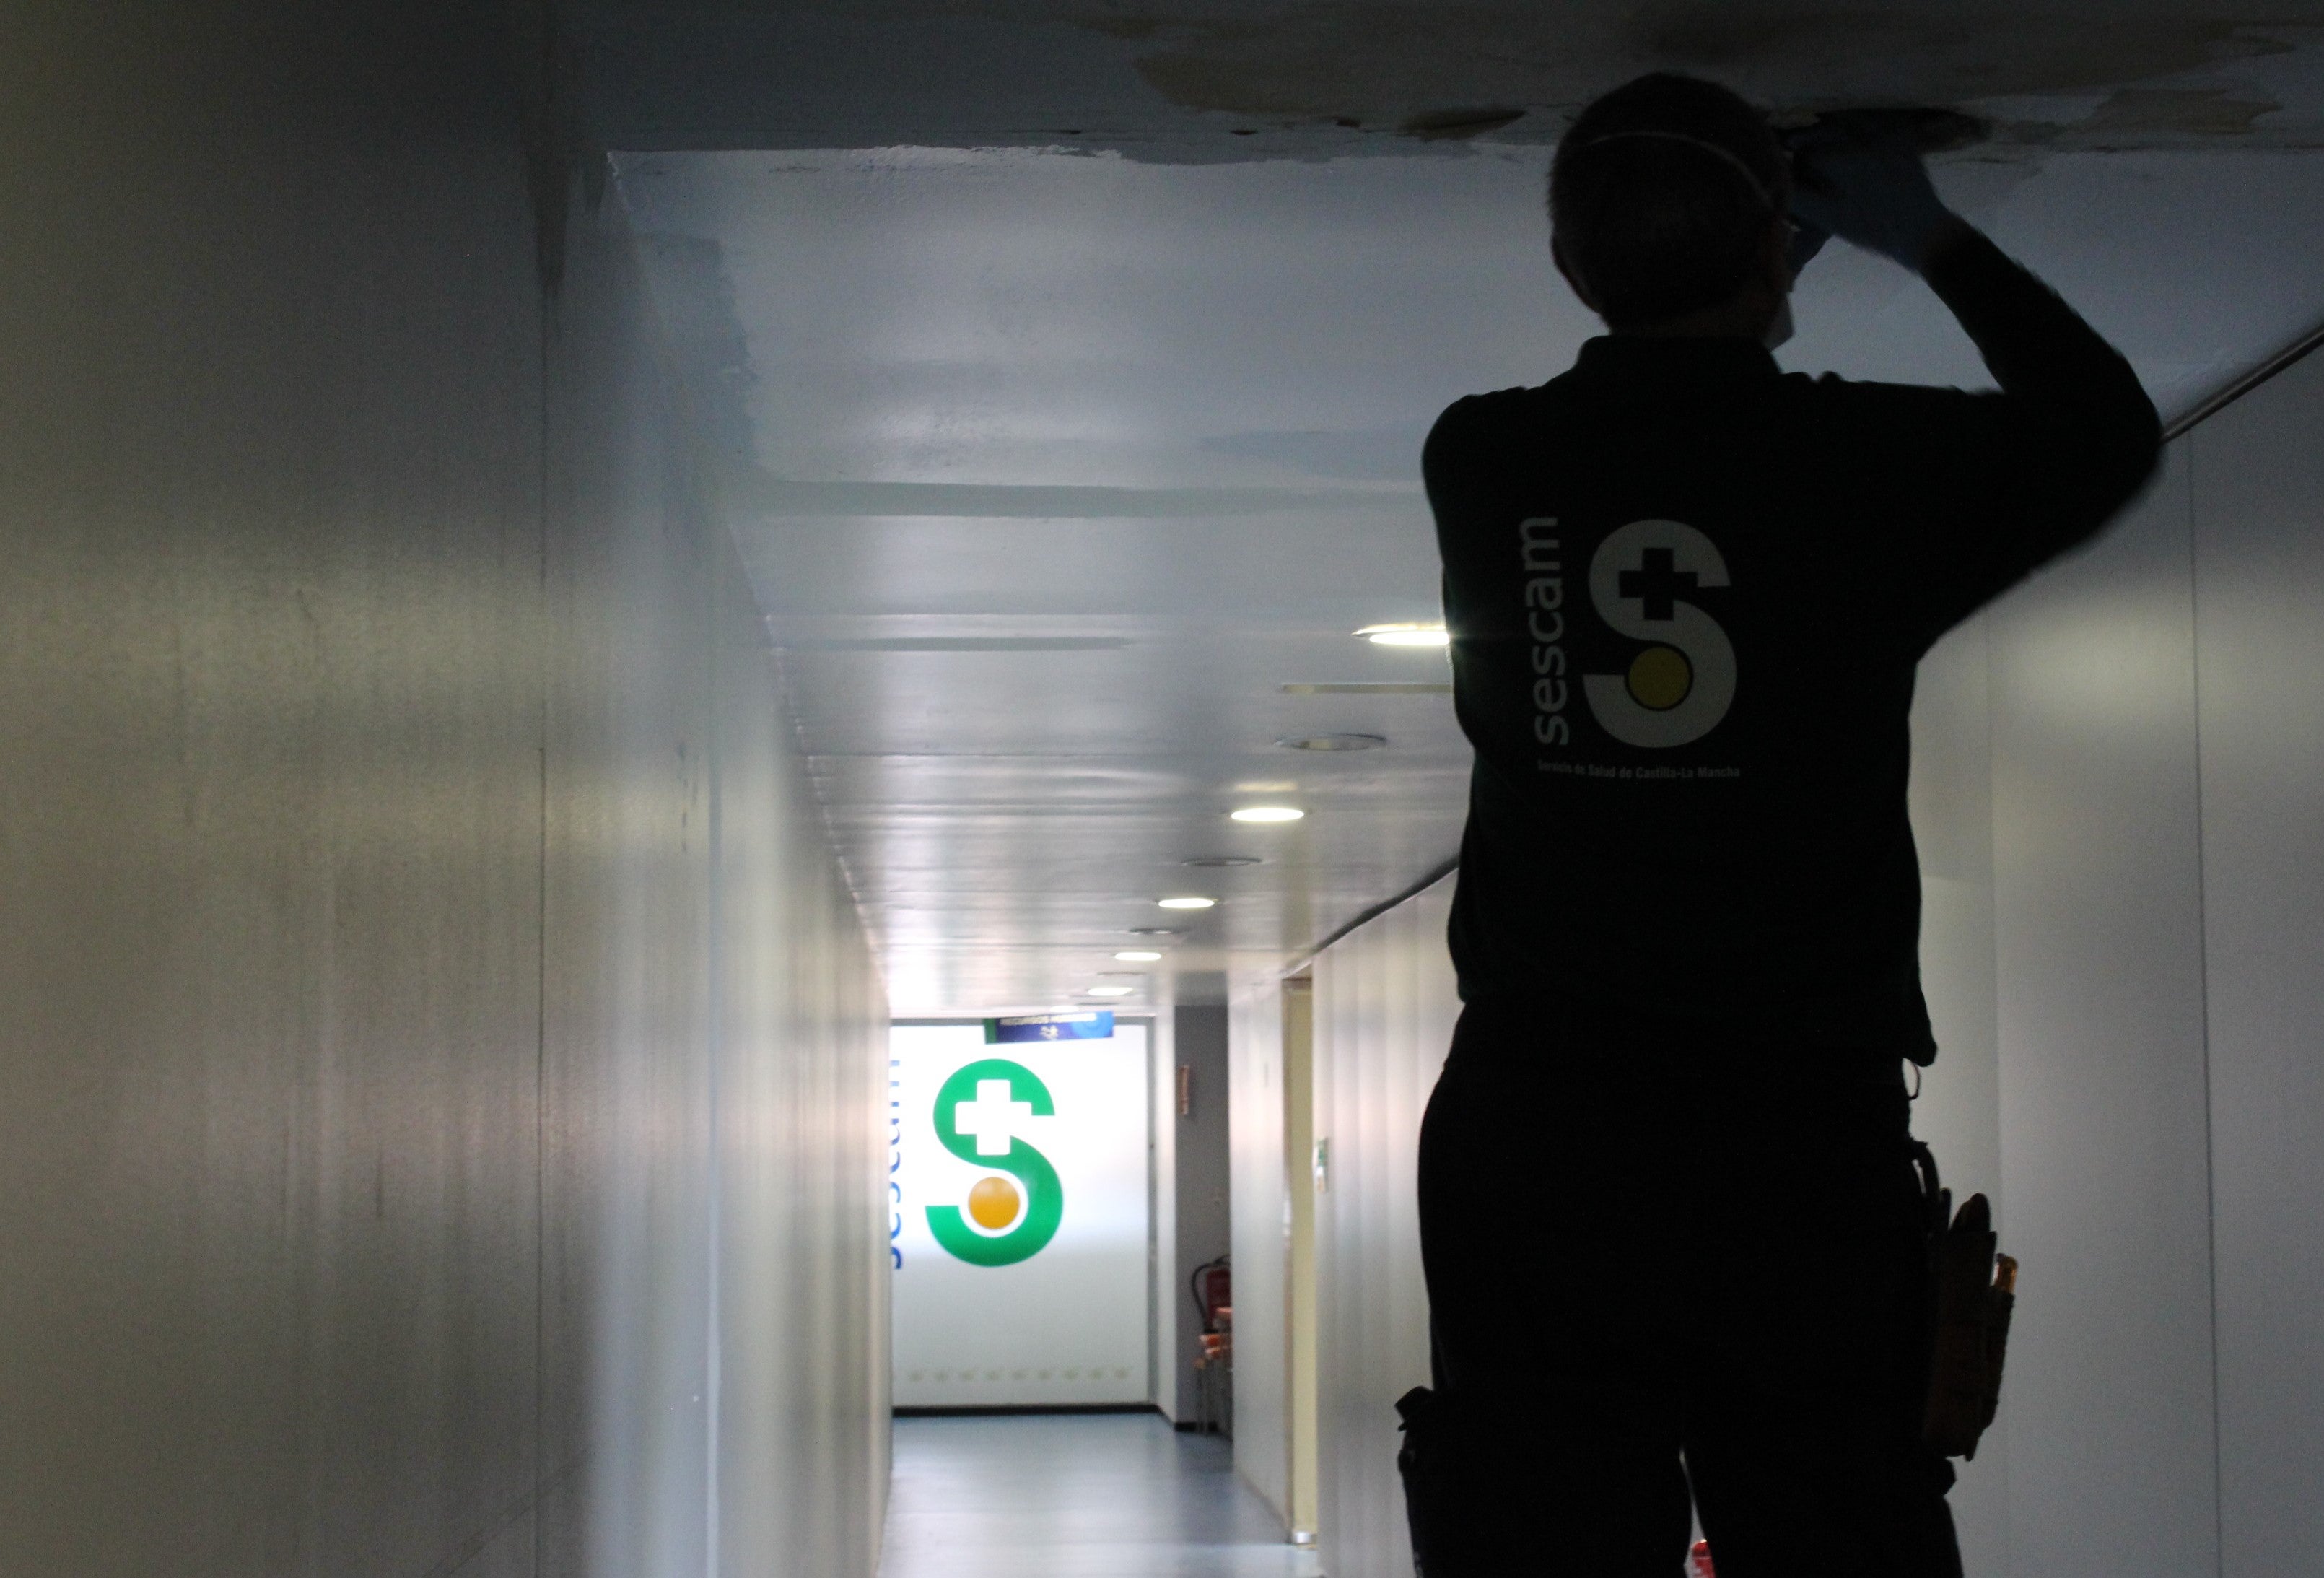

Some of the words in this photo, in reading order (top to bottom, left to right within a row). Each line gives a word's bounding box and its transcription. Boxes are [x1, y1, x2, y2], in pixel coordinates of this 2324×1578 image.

[1519, 516, 1569, 746] sescam
[1588, 764, 1616, 778] Salud
[1619, 766, 1632, 779] de
[1635, 766, 1694, 779] Castilla-La
[1697, 766, 1740, 778] Mancha
